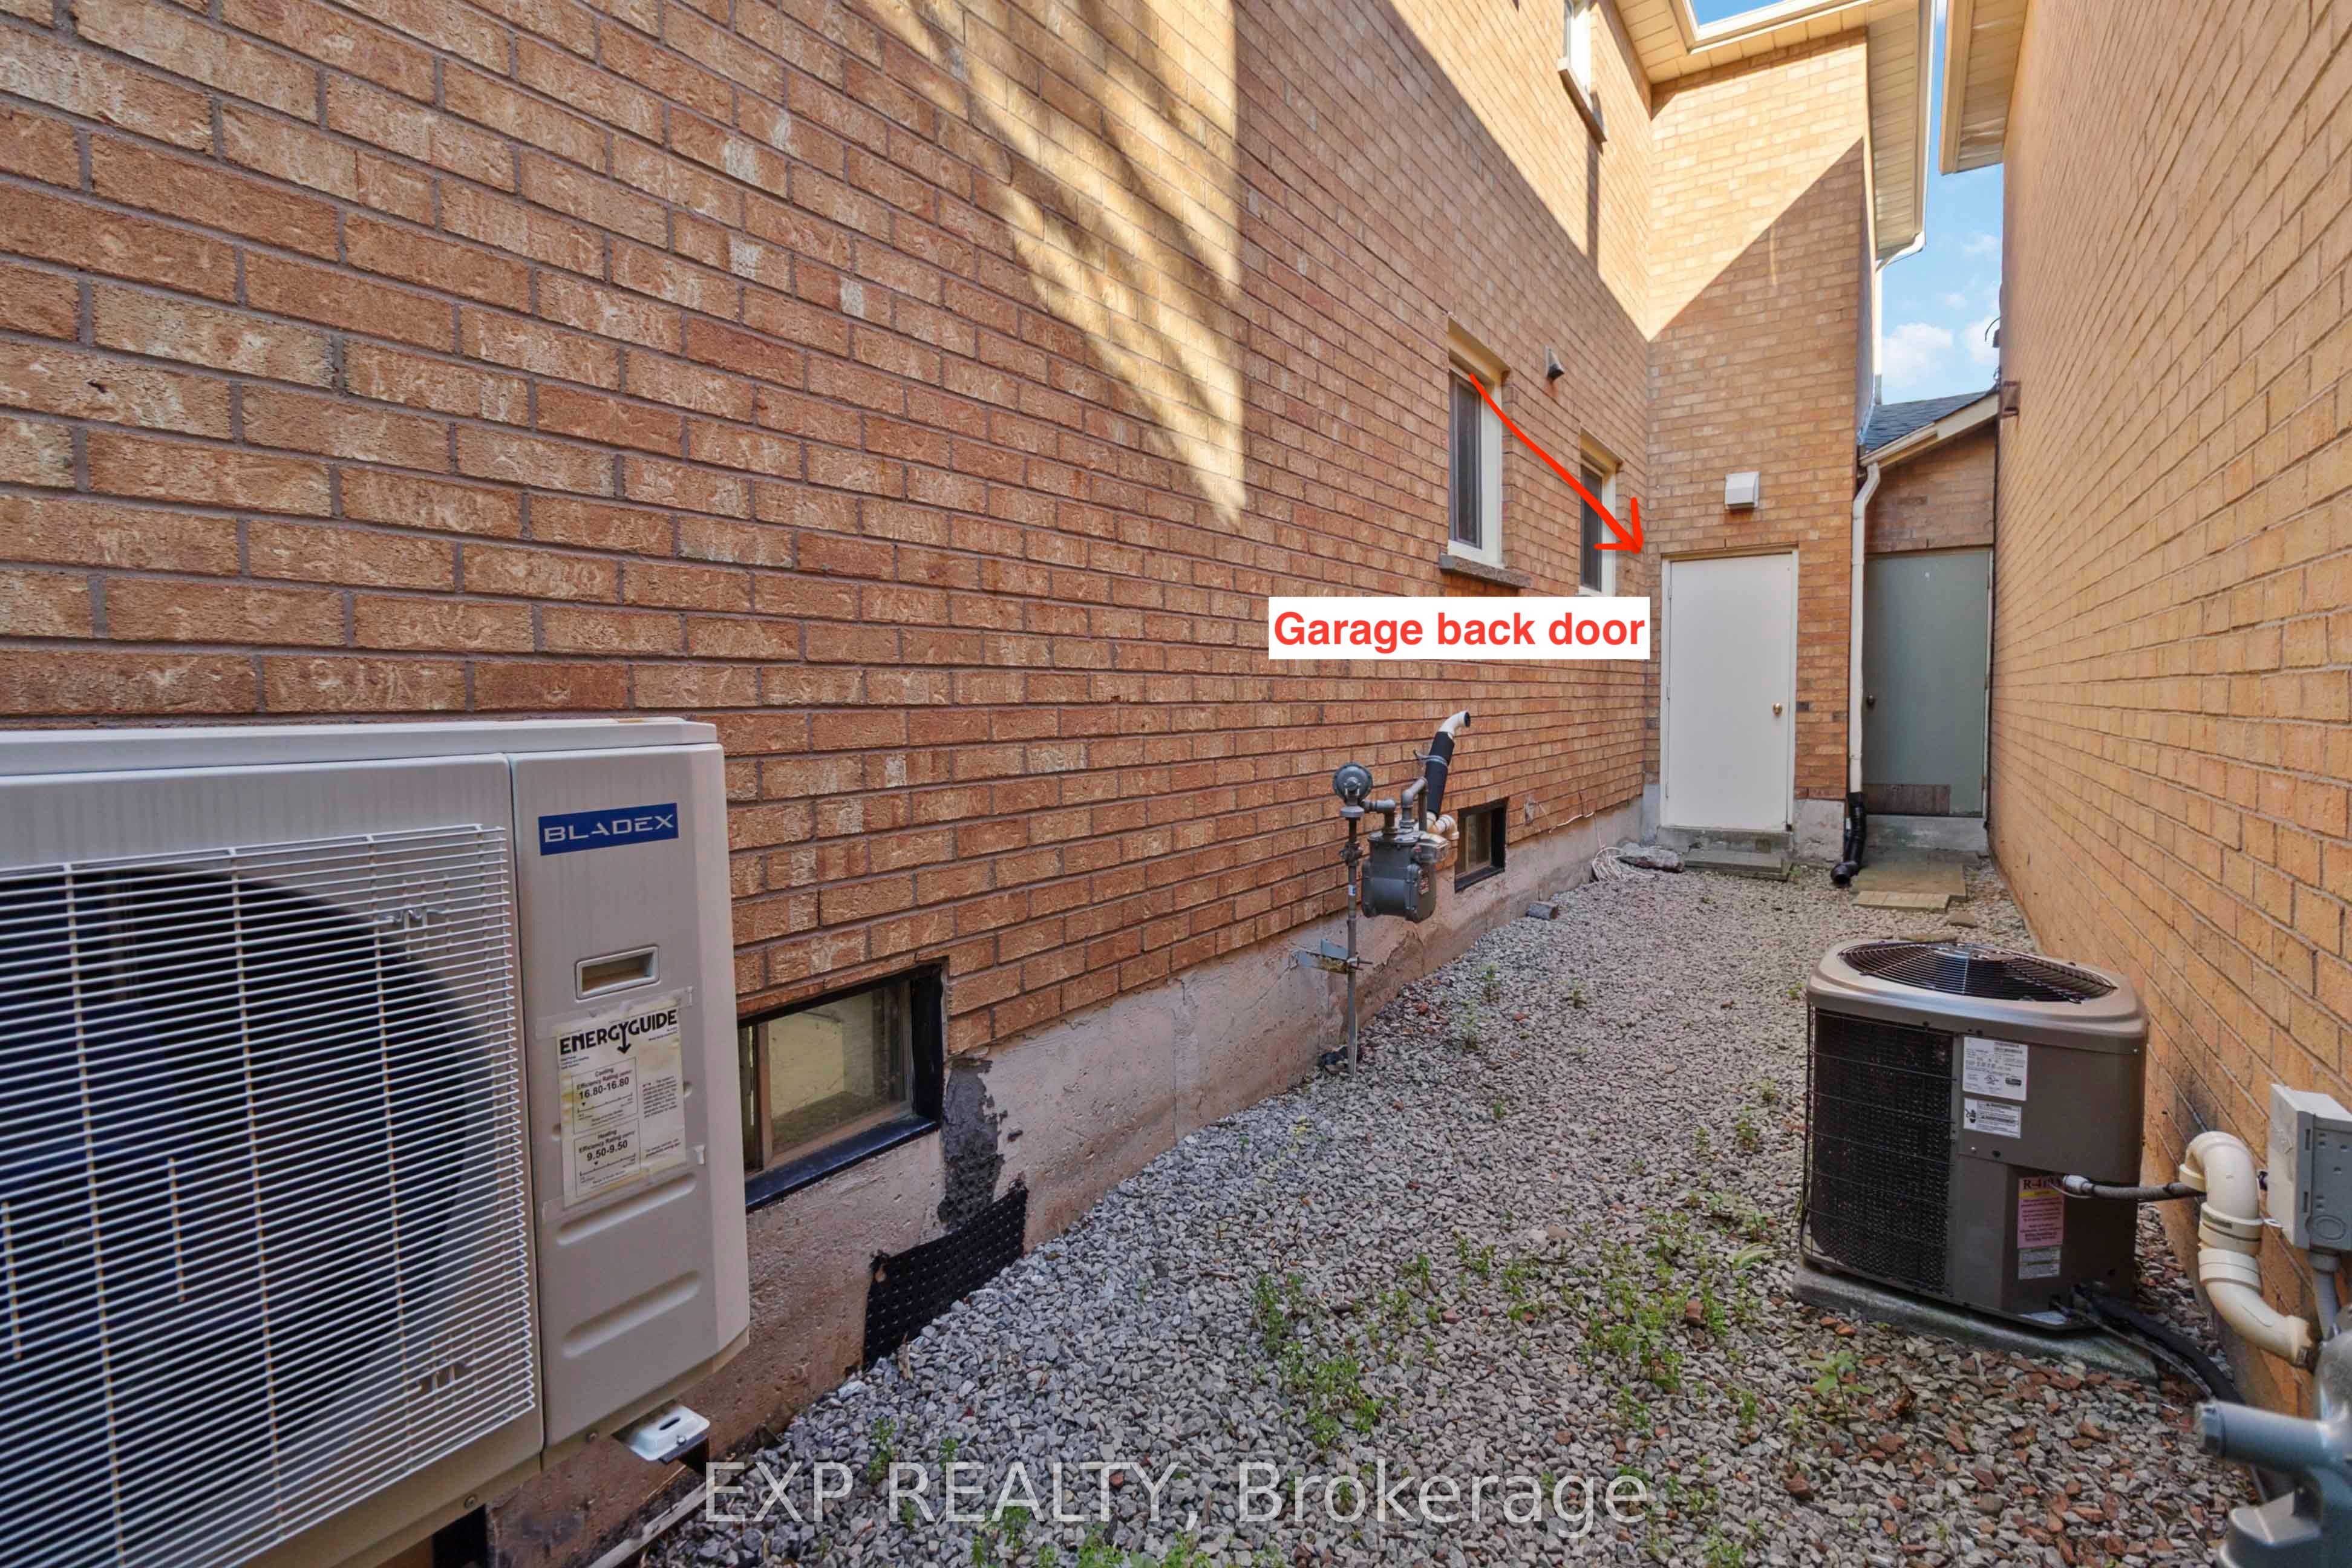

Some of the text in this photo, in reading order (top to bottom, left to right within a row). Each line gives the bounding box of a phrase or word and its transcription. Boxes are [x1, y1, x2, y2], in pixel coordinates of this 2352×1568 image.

[544, 814, 675, 843] BLADEX
[559, 1009, 678, 1055] ENERGYGUIDE
[579, 1076, 630, 1100] 16.80-16.80
[586, 1140, 628, 1161] 9.50-9.50
